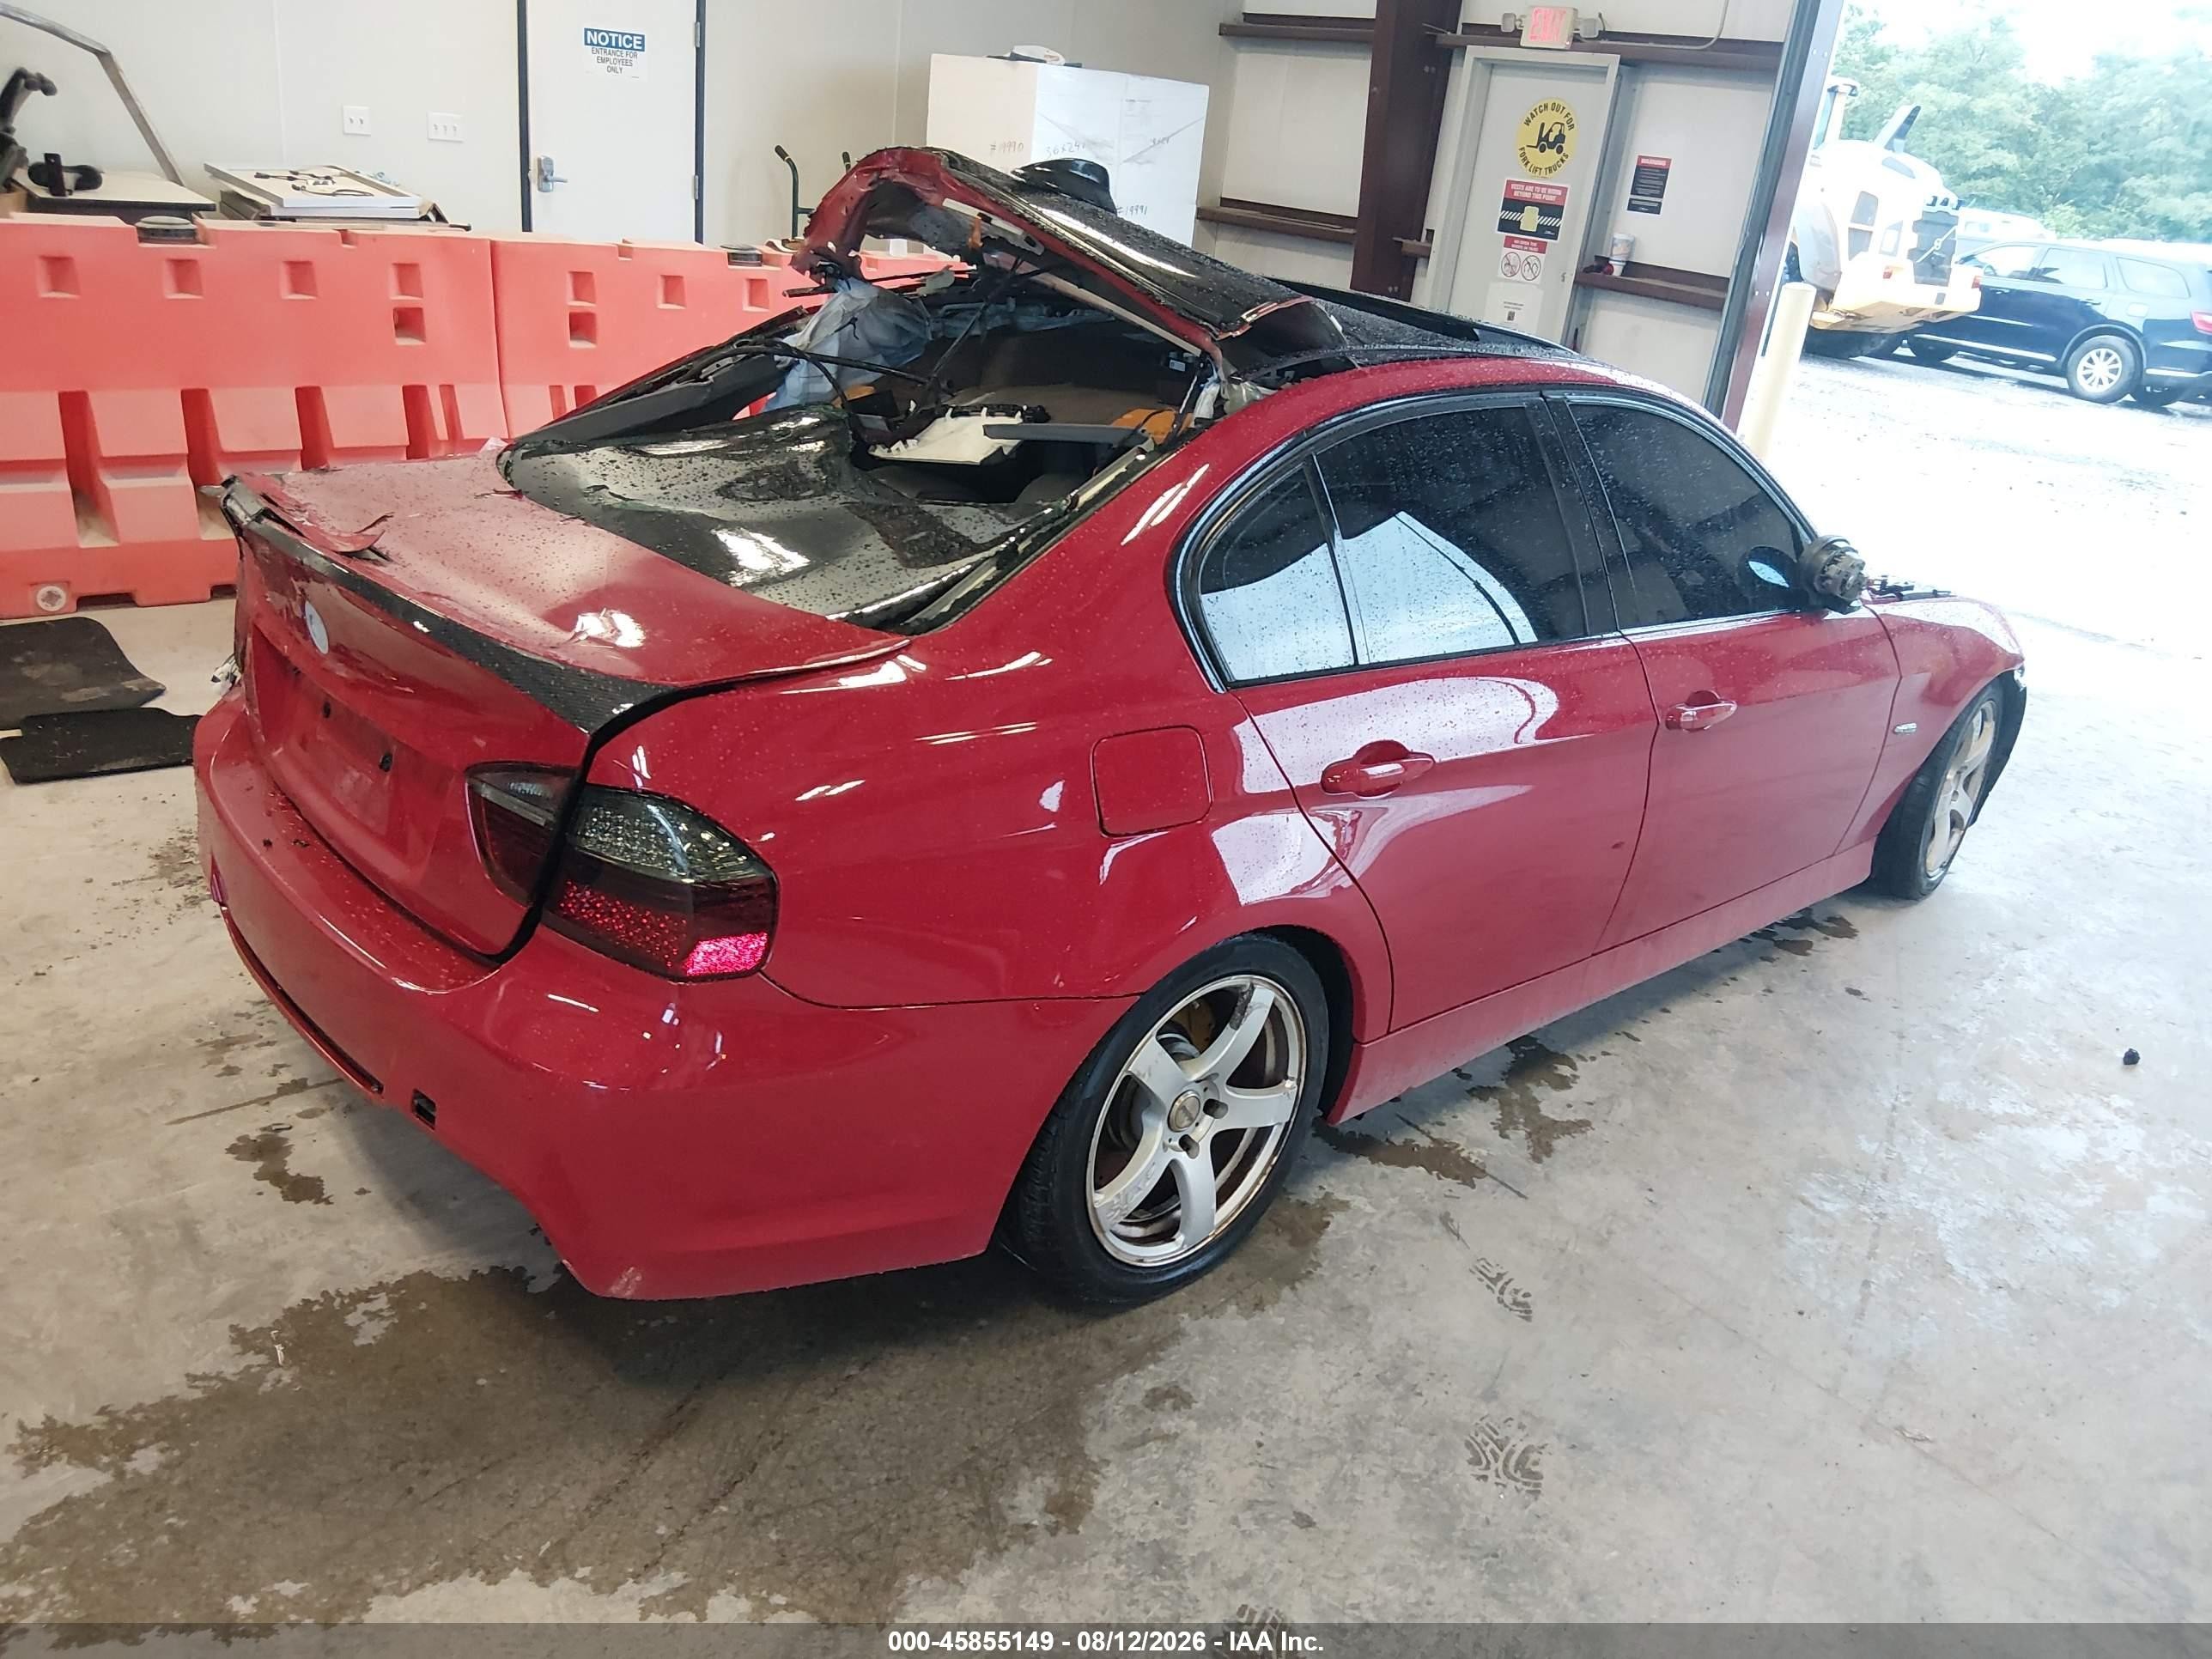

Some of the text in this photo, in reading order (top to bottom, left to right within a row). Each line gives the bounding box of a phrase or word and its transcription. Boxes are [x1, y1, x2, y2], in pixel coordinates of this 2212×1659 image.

[586, 30, 643, 50] NOTICE
[591, 47, 638, 60] ENTRANCE FOR
[596, 56, 634, 66] EMPLOYEES
[606, 65, 623, 74] ONLY
[1523, 102, 1575, 131] WATCH OUT FOR
[1518, 146, 1570, 175] FORK LIFT TRUCKS
